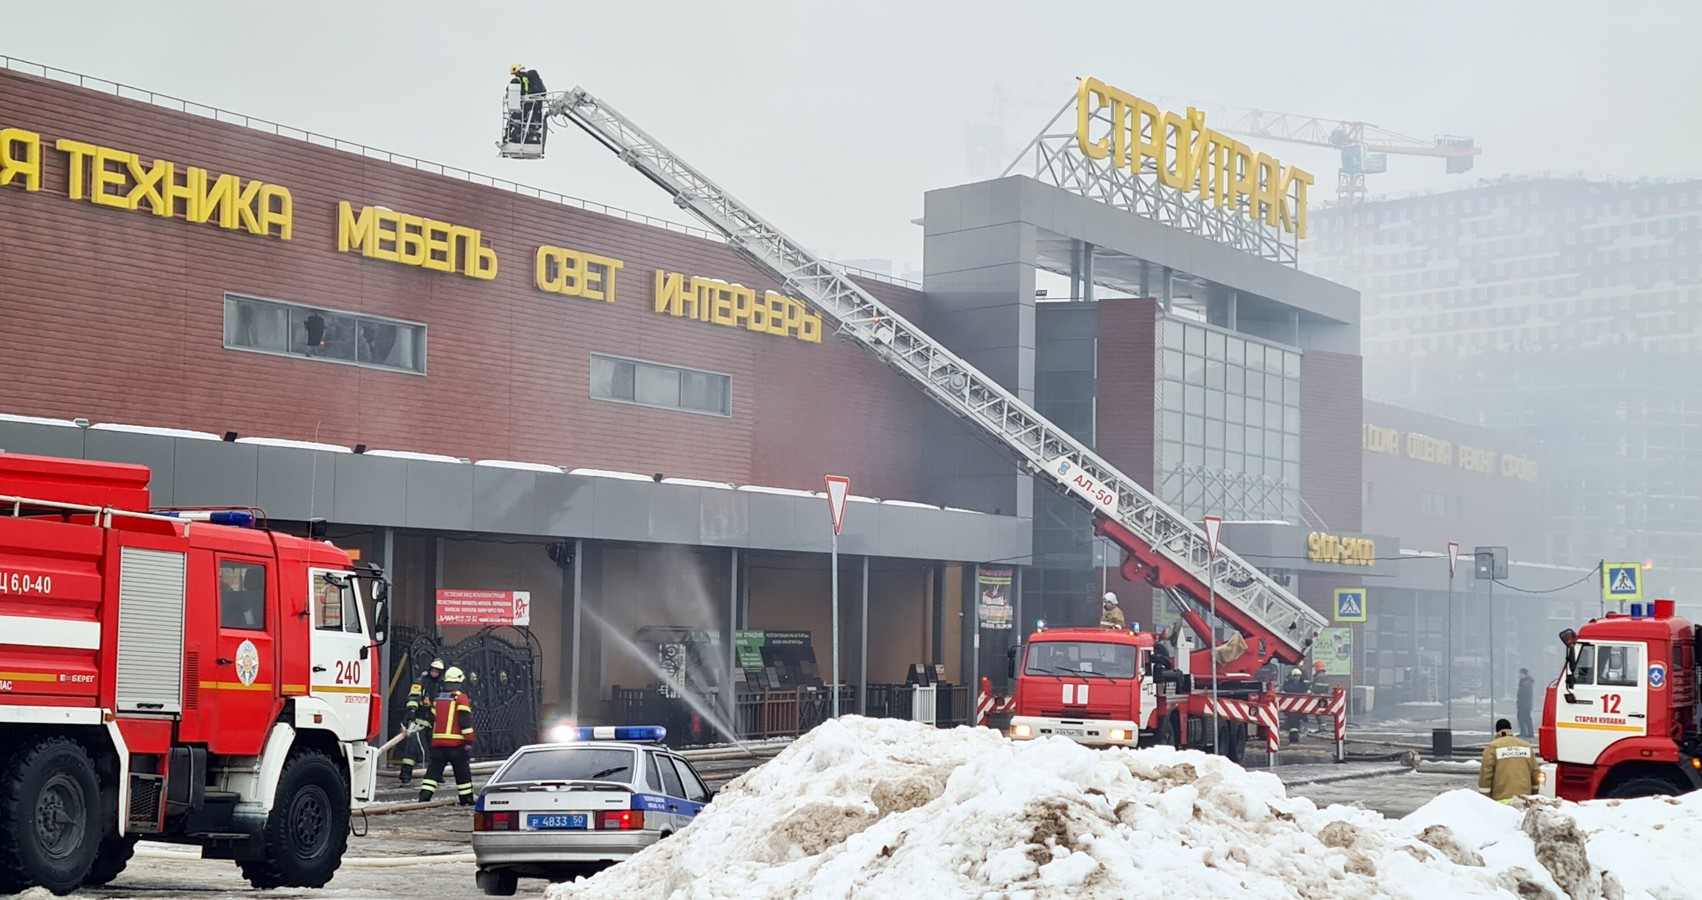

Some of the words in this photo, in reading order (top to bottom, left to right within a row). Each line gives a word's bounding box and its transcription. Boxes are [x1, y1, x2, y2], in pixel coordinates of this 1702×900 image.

[1077, 76, 1314, 239] СТРОЙТРАКТ
[0, 127, 40, 192] Я
[56, 138, 292, 240] ТЕХНИКА
[338, 201, 498, 280] МЕБЕЛЬ
[535, 245, 624, 302] СВЕТ
[654, 269, 822, 343] ИНТЕРЬЕРЫ
[1073, 474, 1113, 506] АЛ-50
[11, 573, 52, 595] 6,0-40
[71, 674, 95, 683] БЕРЕГ
[335, 660, 360, 685] 240
[1600, 693, 1622, 714] 12
[1574, 715, 1598, 723] СТАРАЯ
[542, 816, 568, 827] 4833
[572, 815, 584, 824] 50
